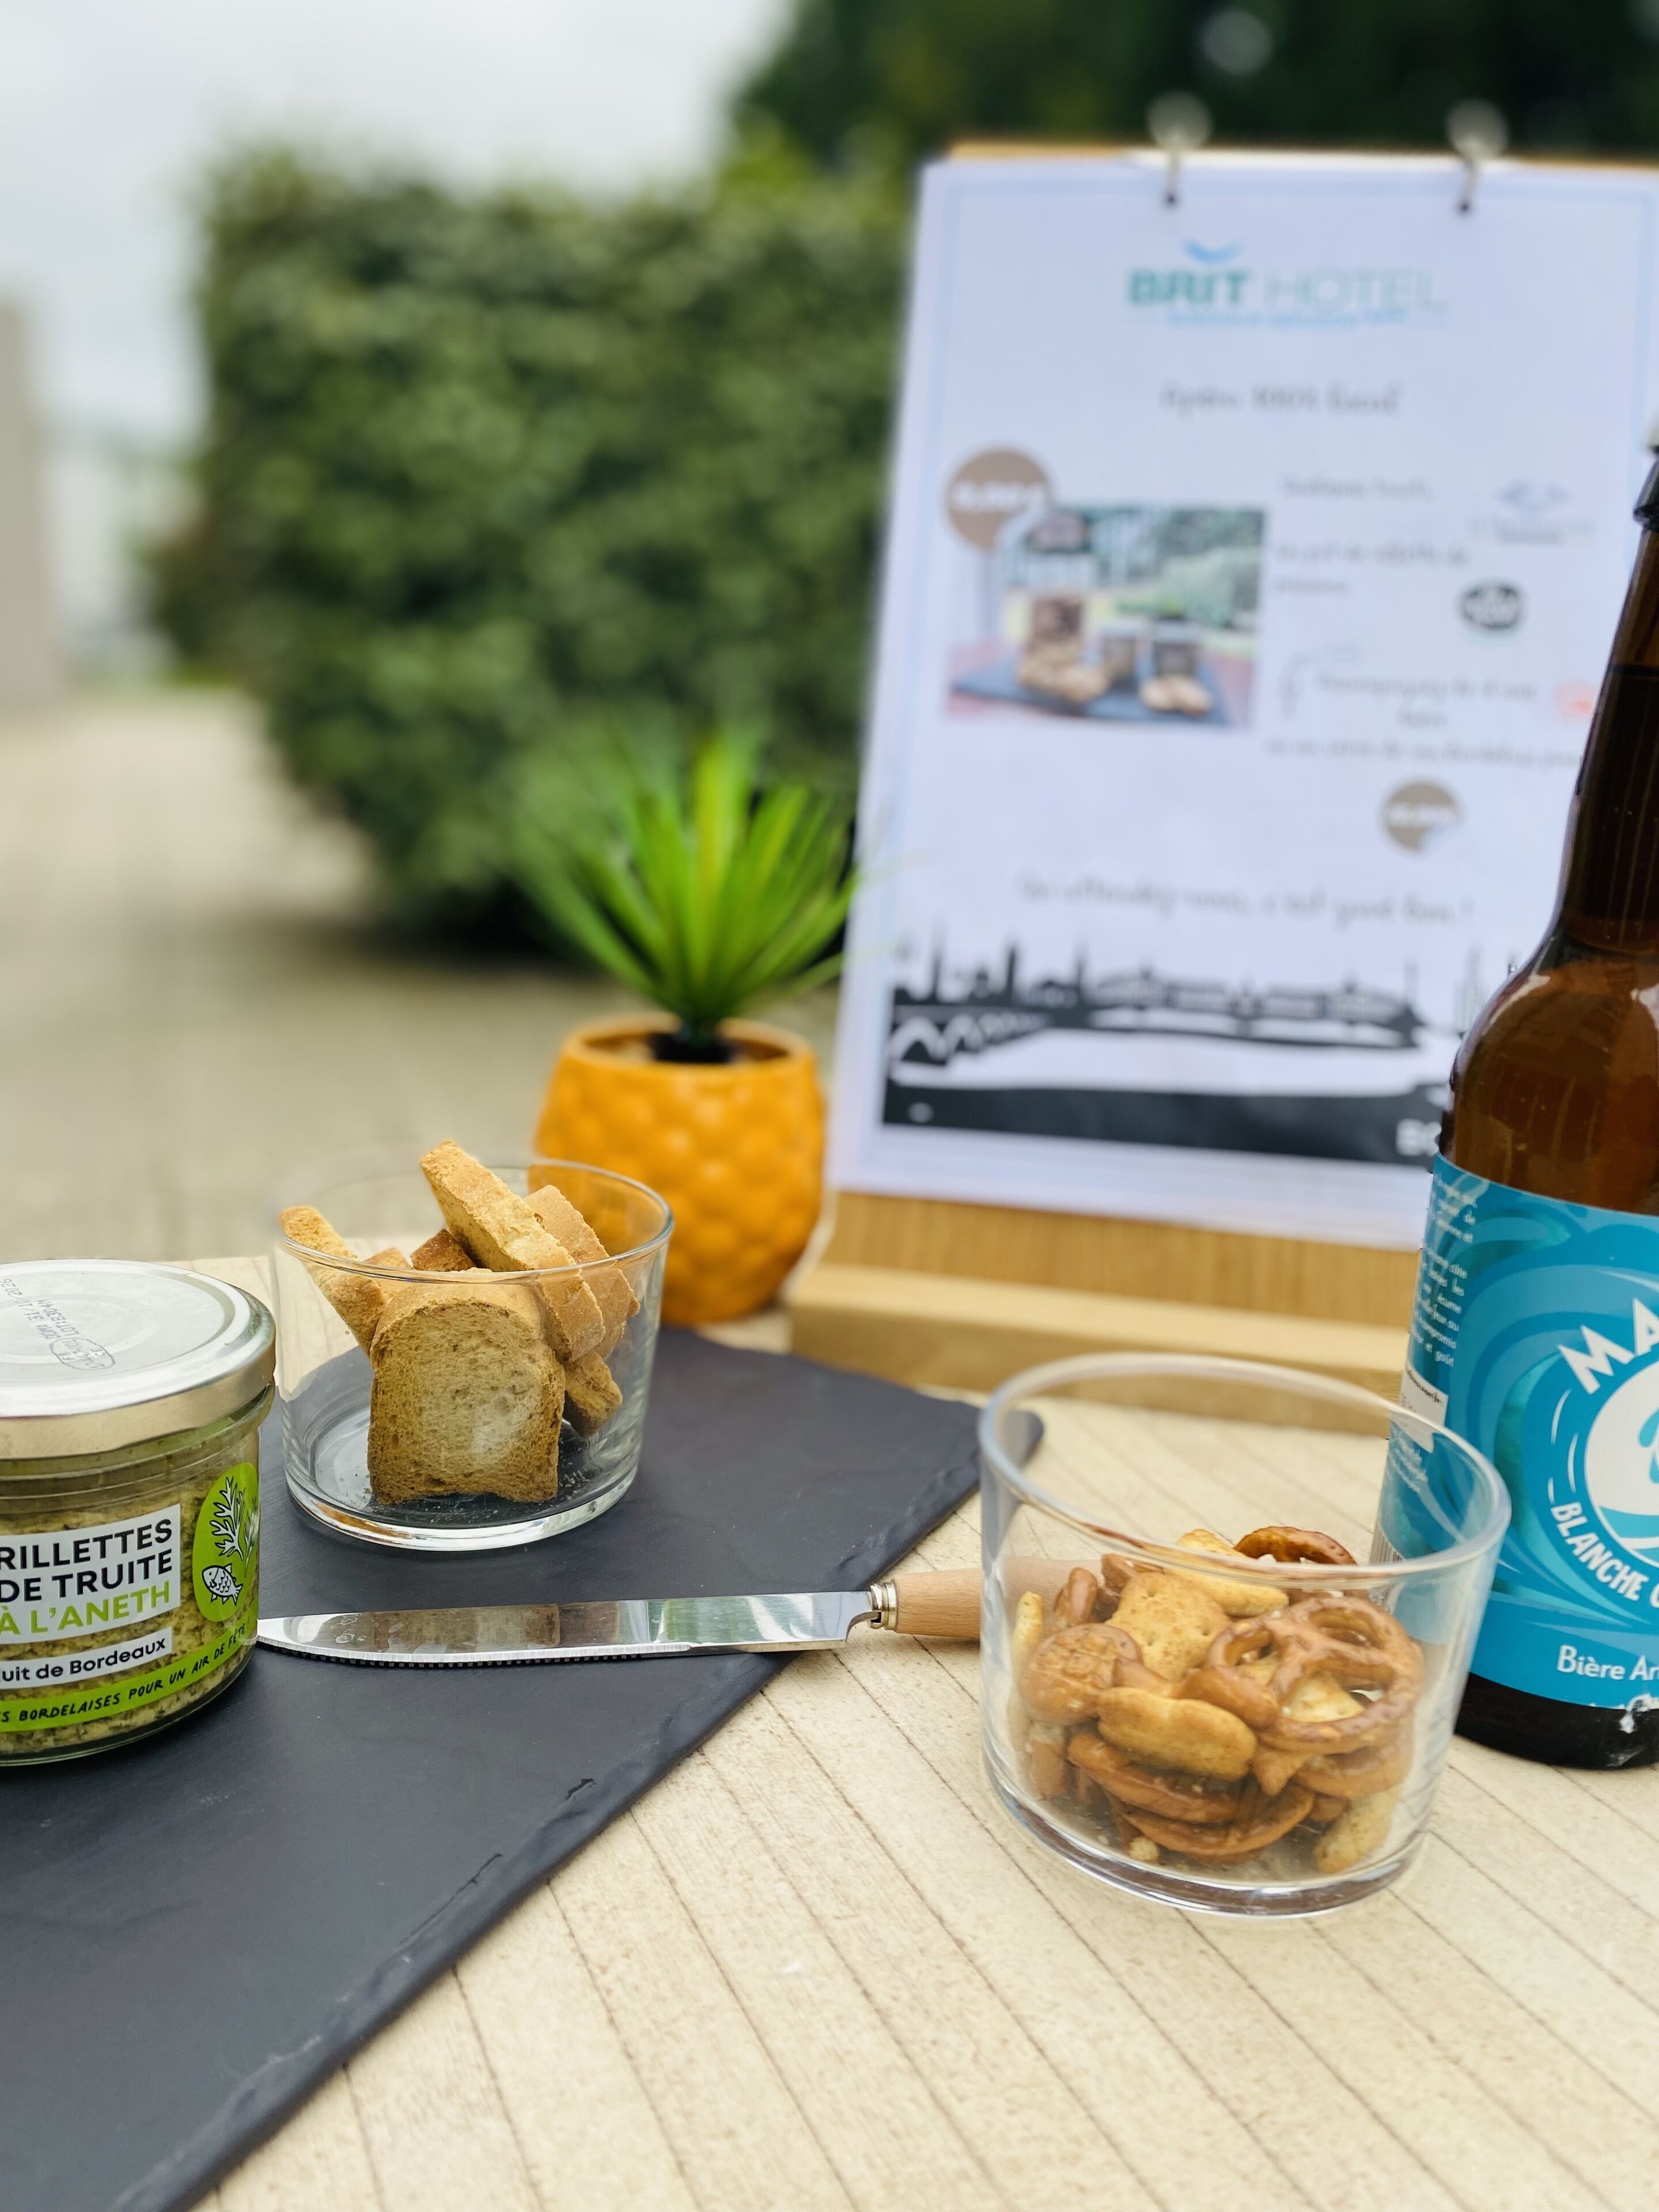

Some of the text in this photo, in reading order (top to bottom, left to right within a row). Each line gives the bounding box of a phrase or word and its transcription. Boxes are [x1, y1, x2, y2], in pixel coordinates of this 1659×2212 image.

[1127, 267, 1448, 314] BRIT HOTEL
[0, 1518, 172, 1570] RILLETTES
[1550, 1502, 1650, 1601] BLANCHE
[0, 1548, 172, 1603] DE TRUITE
[0, 1580, 169, 1635] À L'ANETH
[0, 1711, 10, 1722] S
[19, 1693, 120, 1721] BORDELAISES
[128, 1680, 164, 1699] POUR
[169, 1668, 186, 1684] UN
[192, 1656, 210, 1674] AIR
[214, 1643, 225, 1660] DE
[228, 1623, 245, 1649] FÊTE
[36, 1664, 63, 1679] de
[70, 1638, 165, 1675] Bordeaux
[1556, 1645, 1626, 1680] Bière
